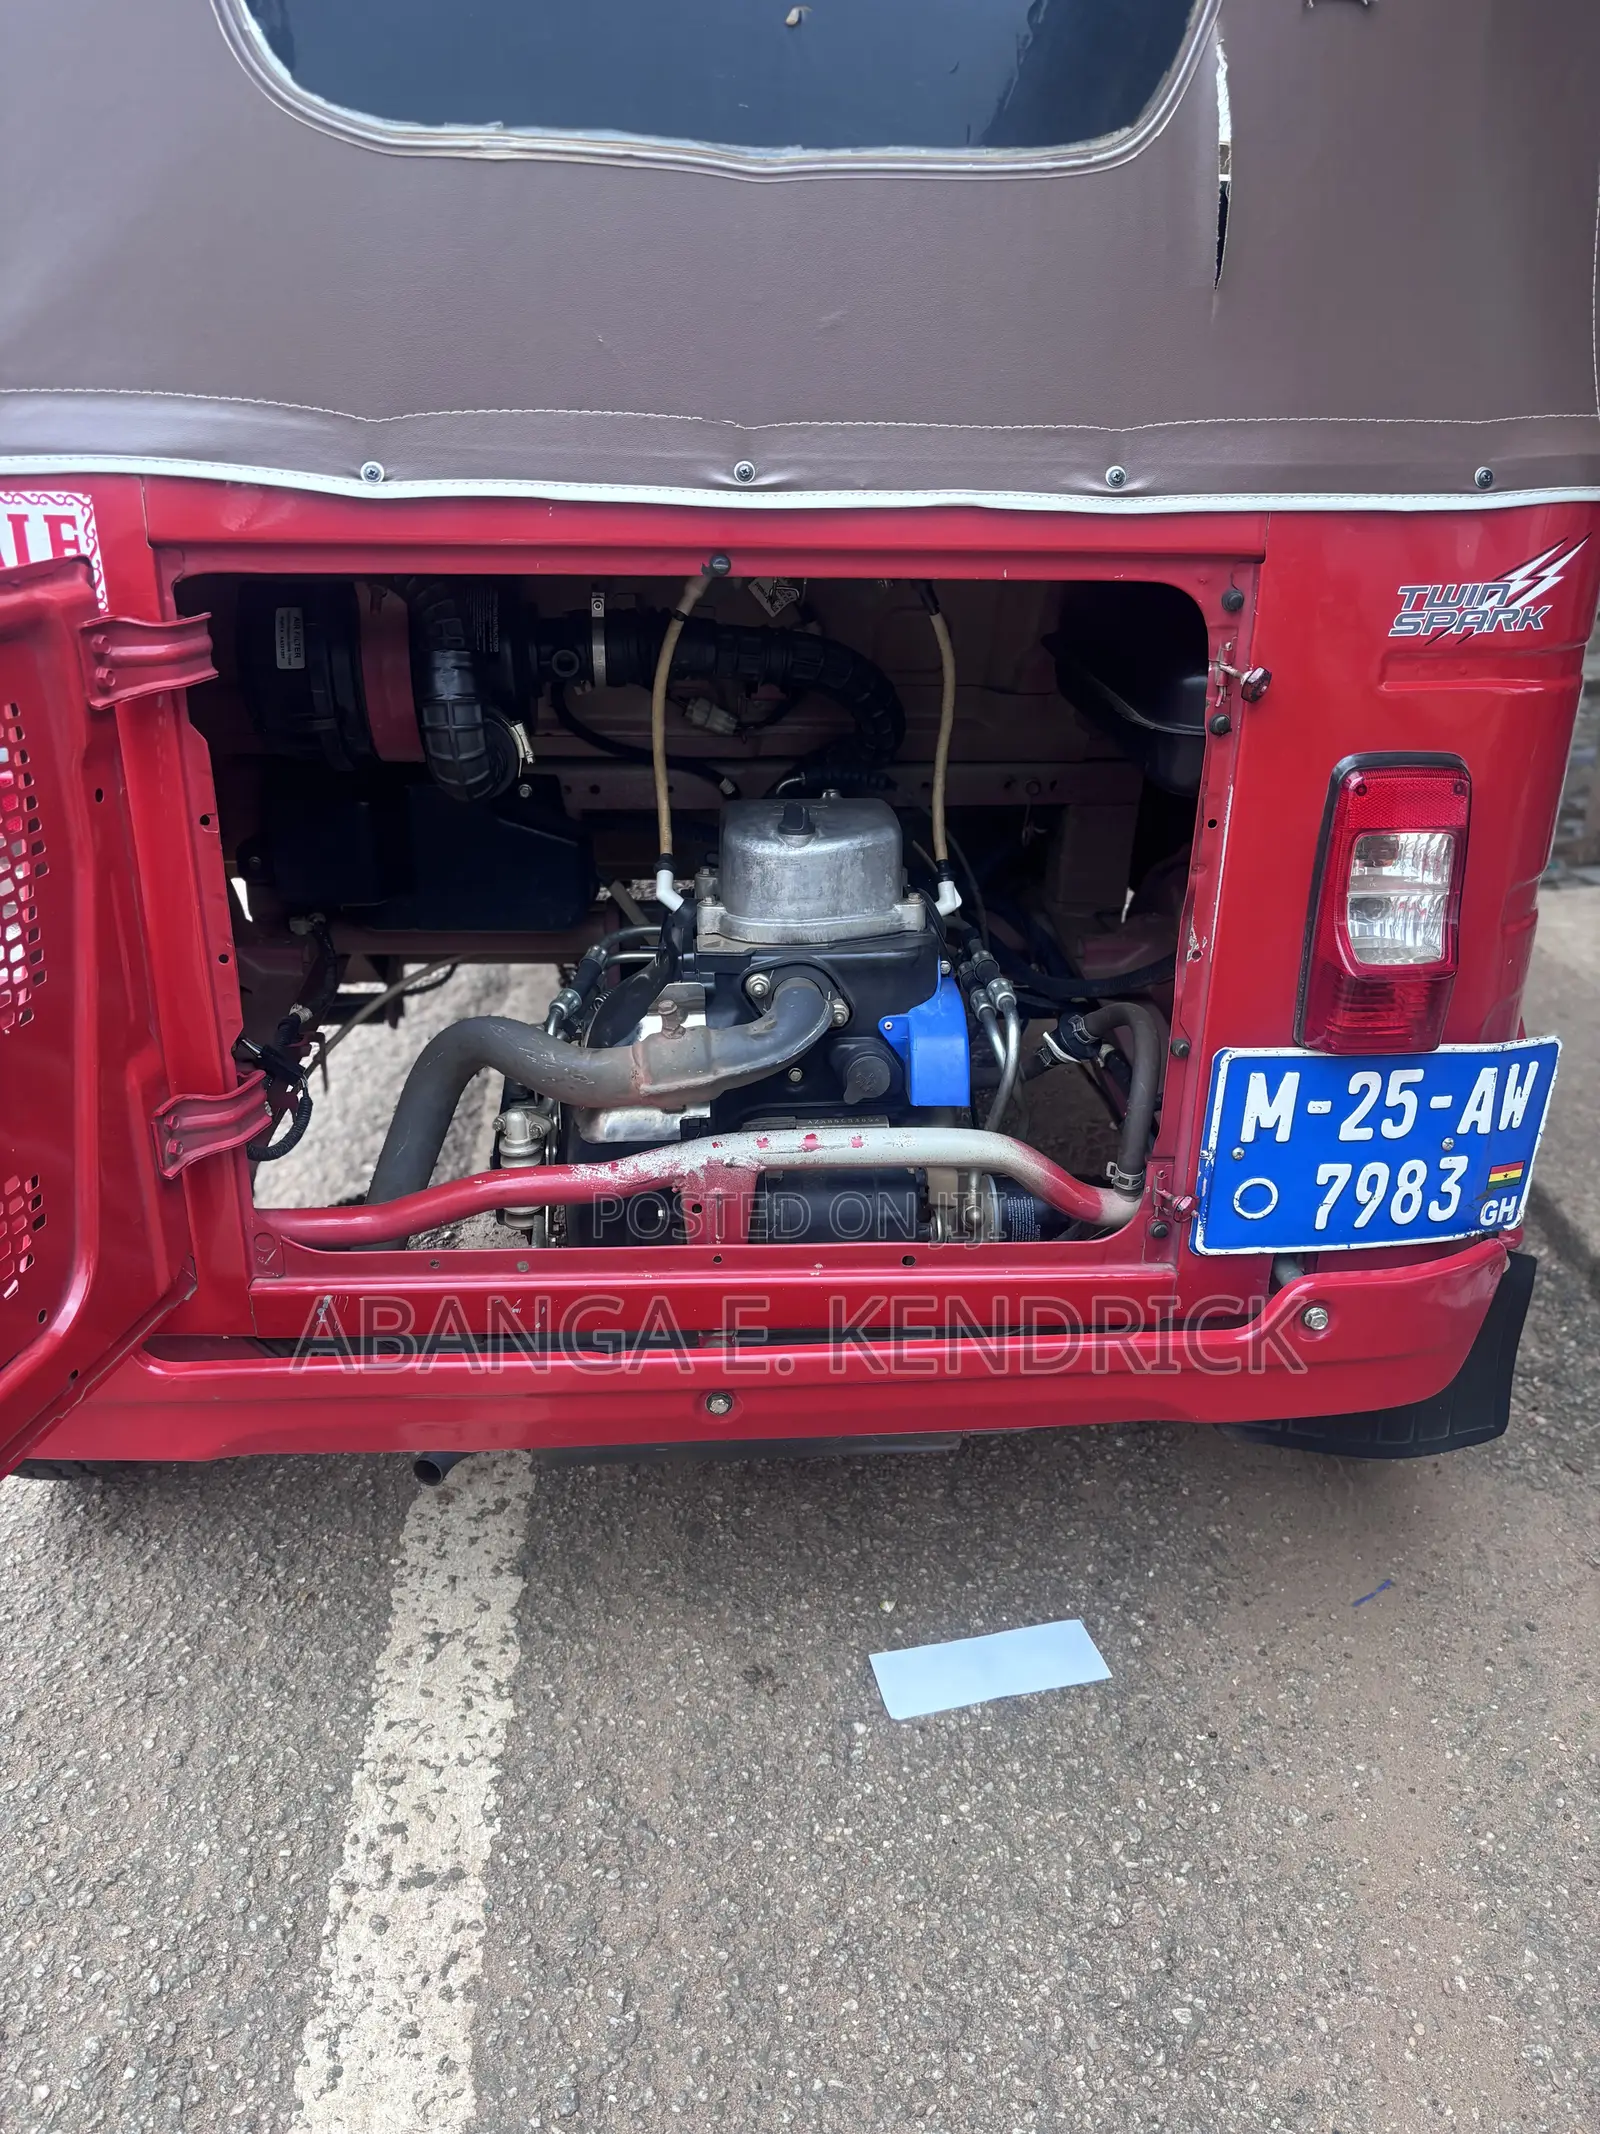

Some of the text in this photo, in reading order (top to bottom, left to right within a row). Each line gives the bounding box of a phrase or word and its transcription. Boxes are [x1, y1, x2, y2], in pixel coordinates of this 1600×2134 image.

[1397, 582, 1512, 610] TWIN
[1388, 605, 1552, 637] SPARK
[1240, 1061, 1539, 1143] M-25-AW
[1314, 1155, 1469, 1231] 7983
[1479, 1195, 1517, 1226] GH
